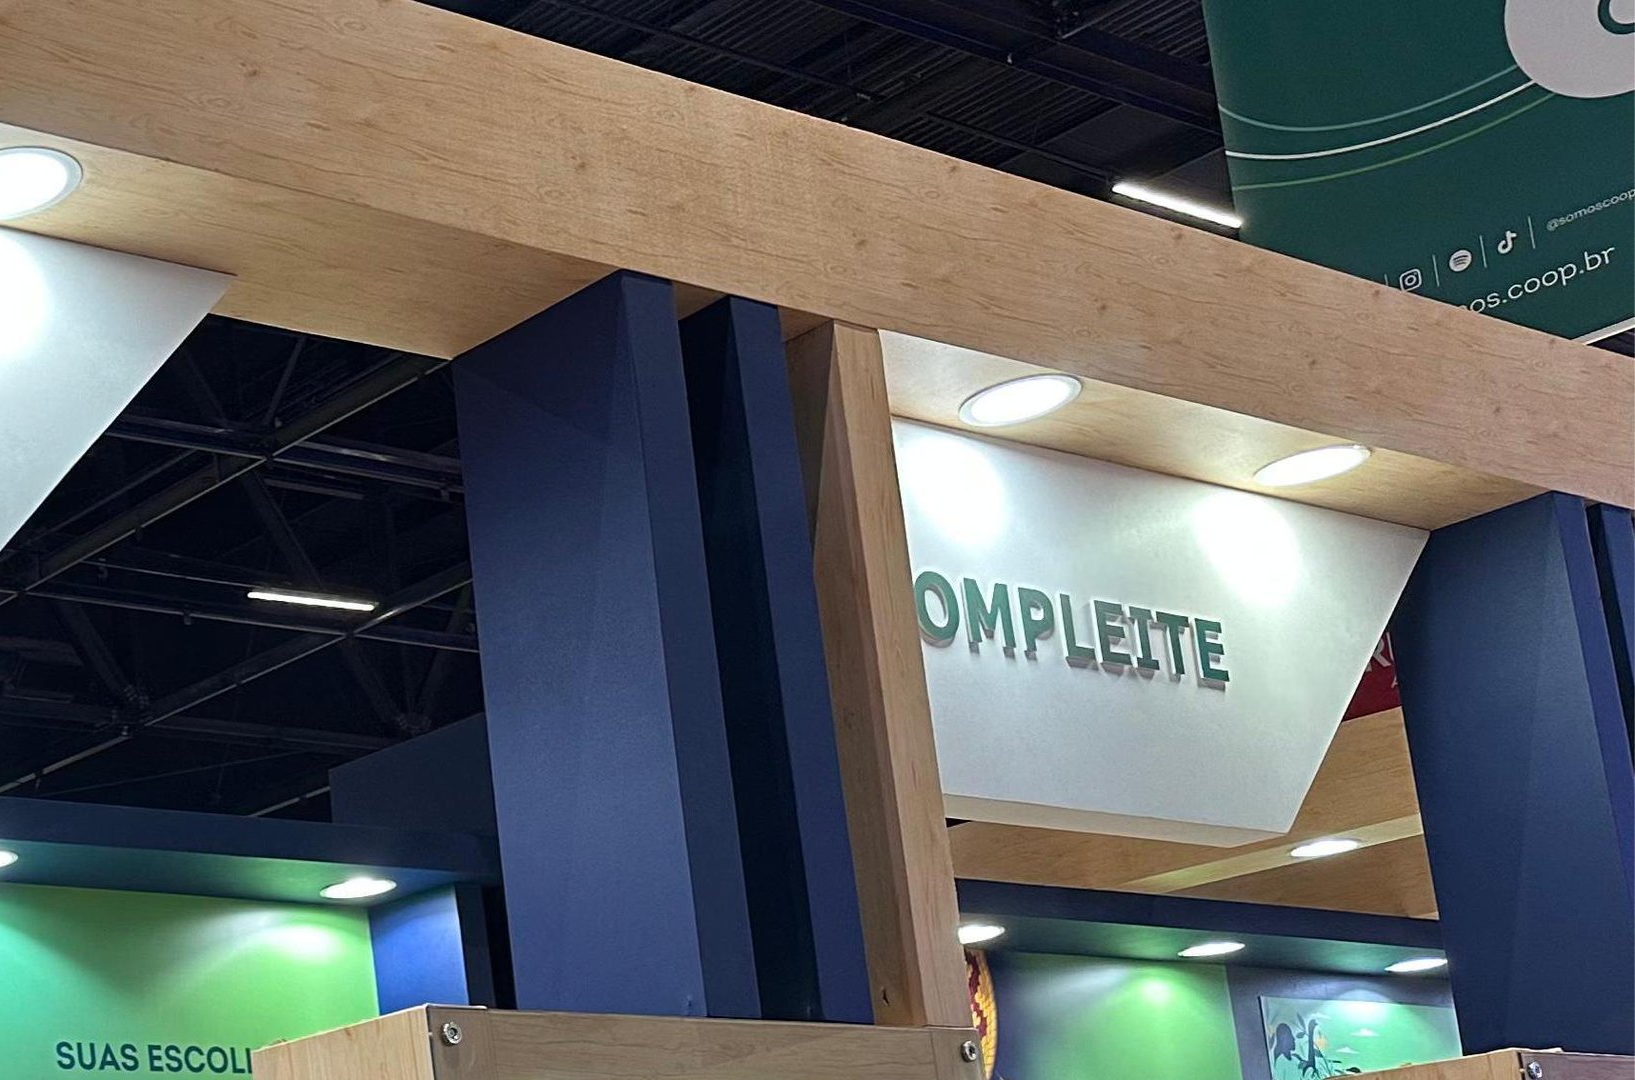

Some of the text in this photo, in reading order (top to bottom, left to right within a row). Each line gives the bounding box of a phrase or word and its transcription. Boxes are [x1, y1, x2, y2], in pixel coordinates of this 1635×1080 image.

[1458, 246, 1616, 314] os.coop.br
[55, 1041, 252, 1075] SUAS ESCOL
